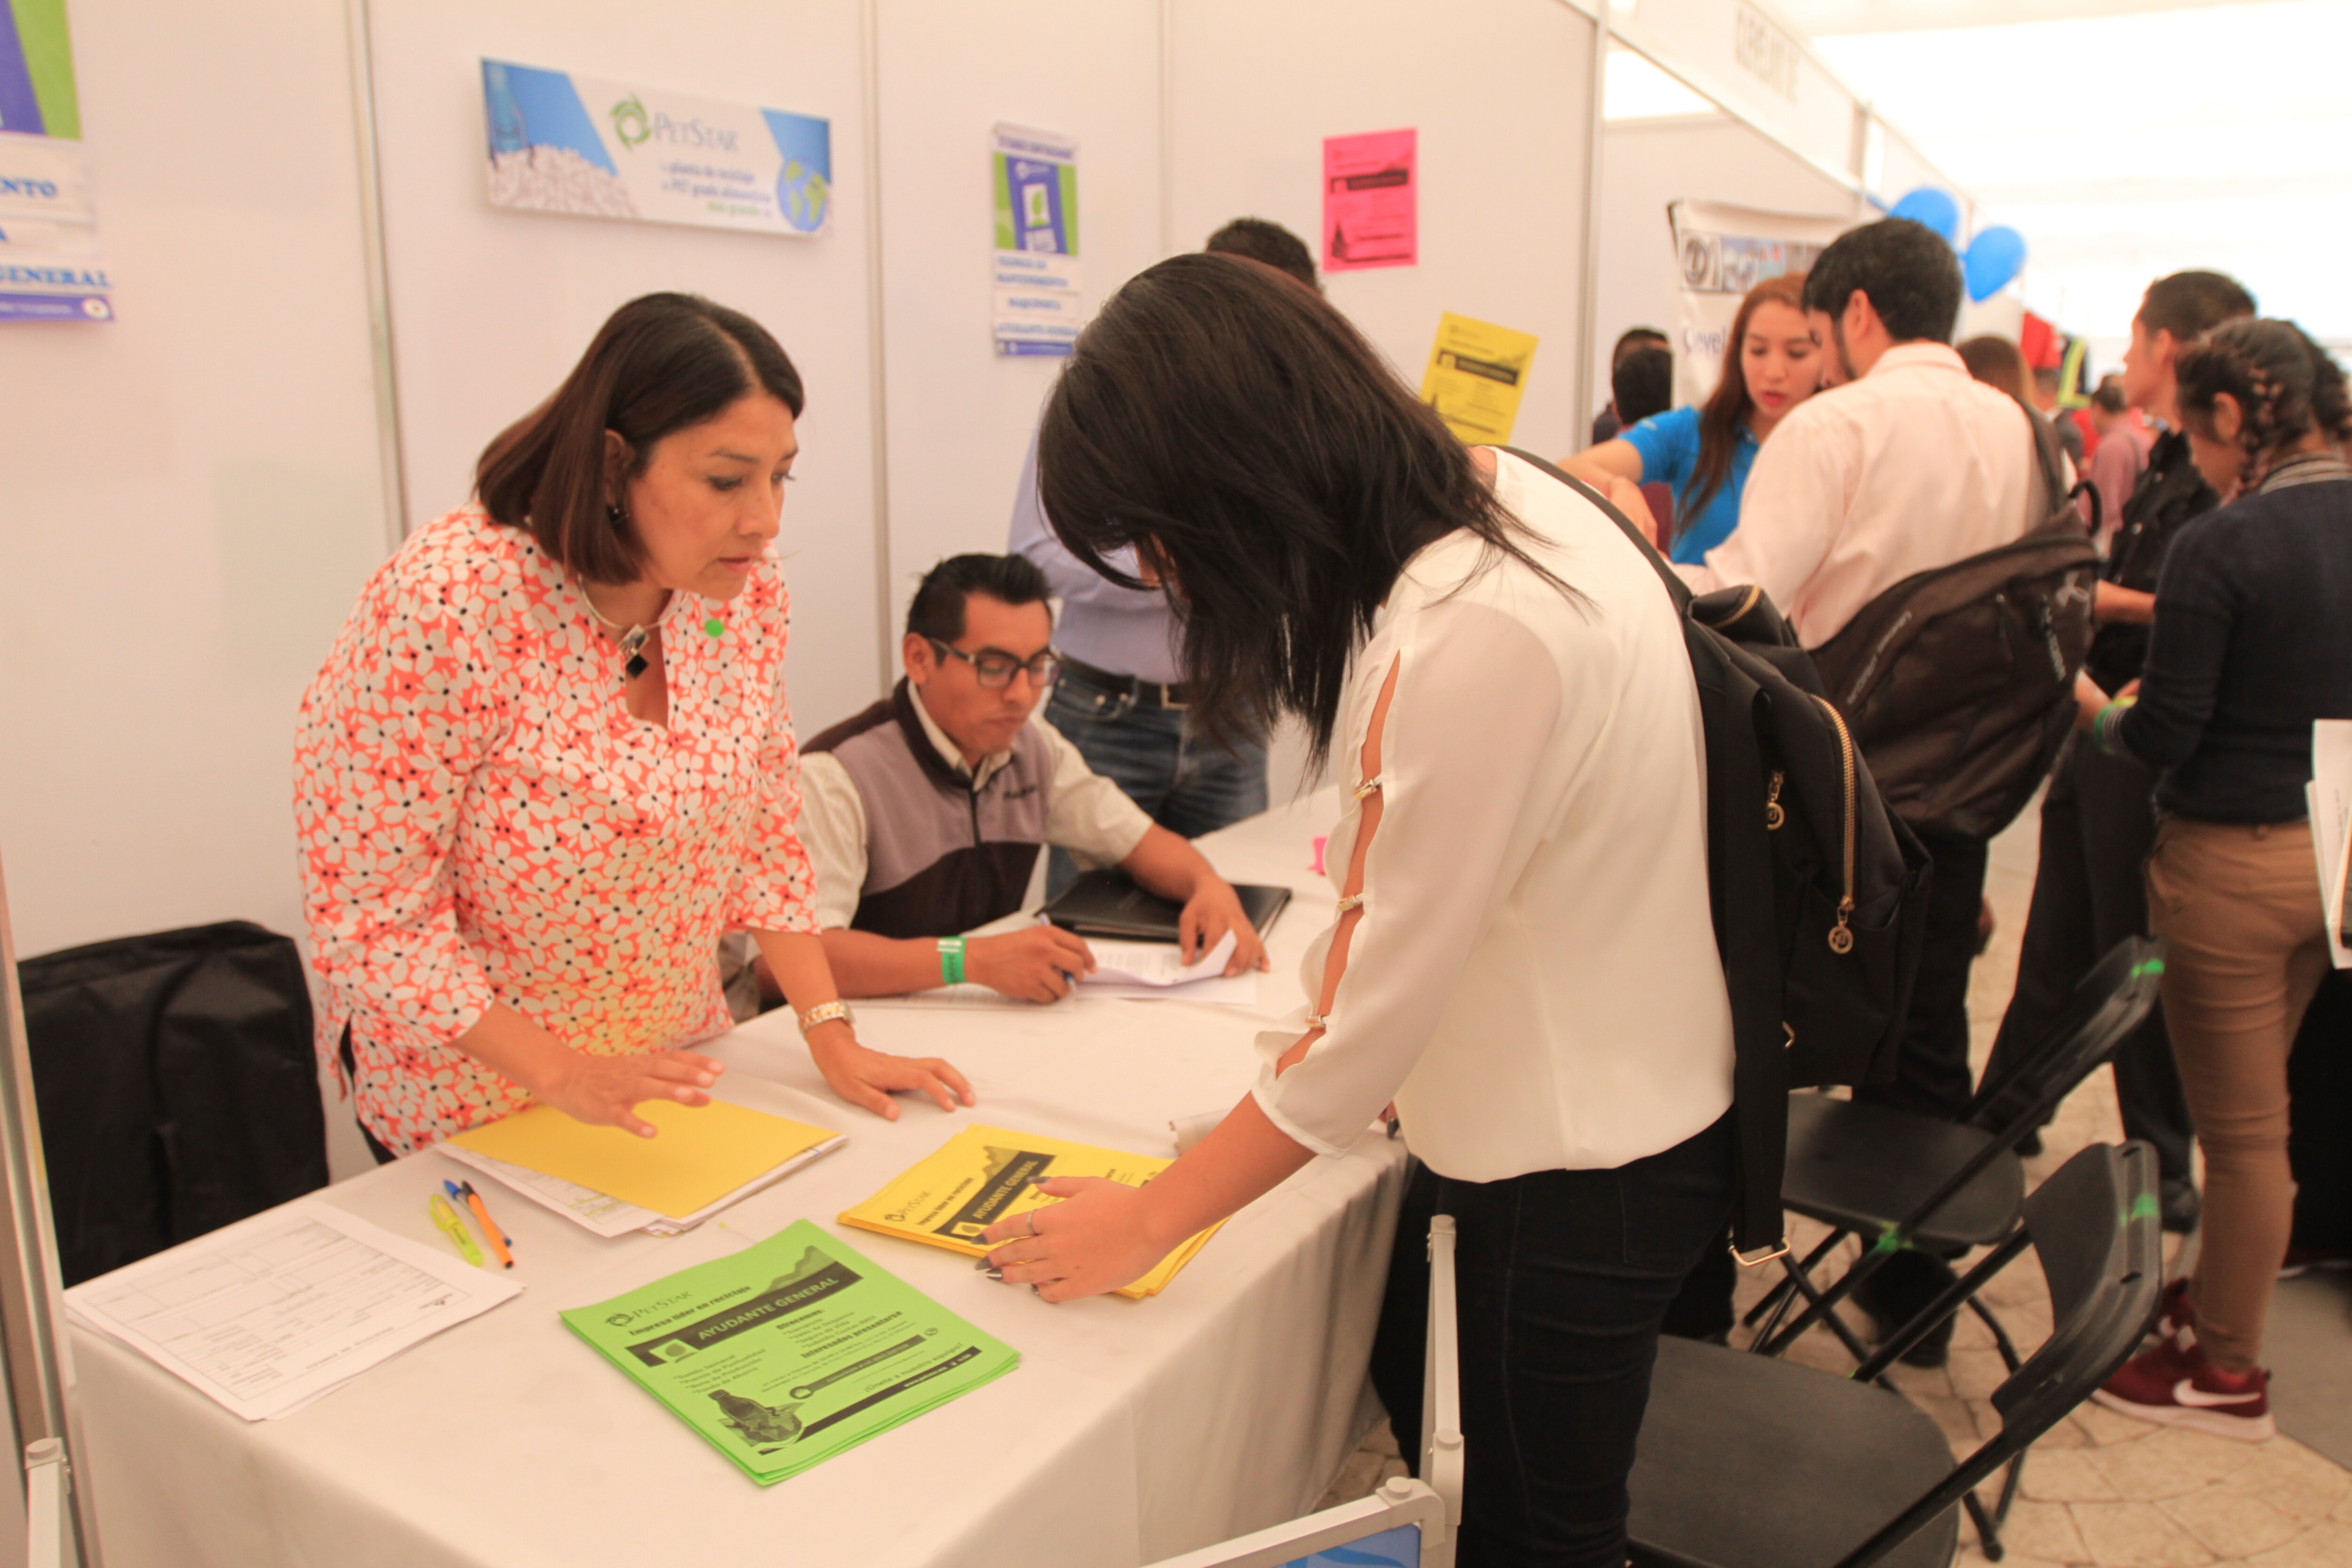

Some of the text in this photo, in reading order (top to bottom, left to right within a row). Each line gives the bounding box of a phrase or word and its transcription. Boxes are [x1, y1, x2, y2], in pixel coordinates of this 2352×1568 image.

[970, 1159, 1040, 1220] AYUDANTE GENERAL
[628, 1316, 674, 1337] Empresa
[694, 1302, 711, 1311] en
[706, 1285, 754, 1305] reciclaje
[692, 1275, 843, 1340] AYUDANTE GENERAL
[799, 1333, 855, 1359] Interesados
[849, 1310, 907, 1337] presentarse
[898, 1359, 934, 1376] nuestro
